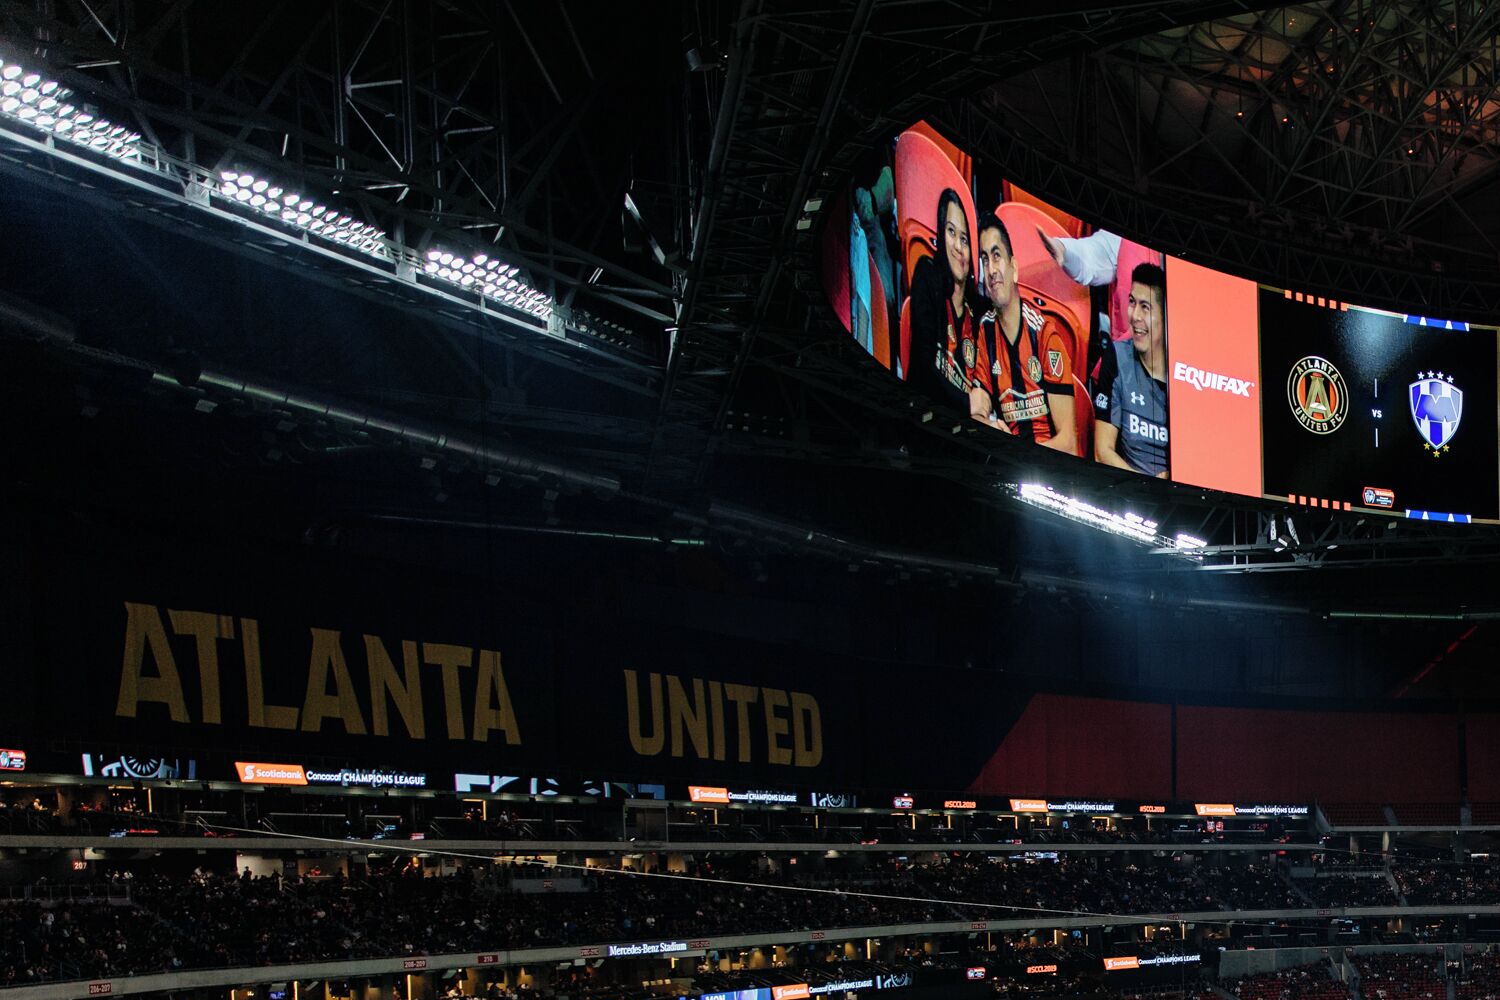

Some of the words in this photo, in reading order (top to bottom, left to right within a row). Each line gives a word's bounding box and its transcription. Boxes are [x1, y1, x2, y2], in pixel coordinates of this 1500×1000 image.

[1173, 361, 1251, 397] EQUIFAX
[1296, 360, 1339, 383] ATLANTA
[1129, 414, 1168, 442] Bana
[1295, 408, 1329, 432] UNITED
[1330, 413, 1342, 429] FC
[115, 601, 522, 747] ATLANTA
[624, 669, 823, 767] UNITED
[256, 768, 302, 780] Scotiabank
[306, 770, 342, 781] Concacaf
[343, 772, 393, 784] CHAMPIONS
[394, 775, 426, 785] LEAGUE
[749, 793, 778, 801] CHAMPIONS
[778, 794, 797, 802] LEAGUE
[944, 801, 976, 809] #SCCL2019
[1257, 806, 1287, 814] CHAMPIONS
[609, 944, 659, 957] Mercedes-Benz
[659, 941, 687, 953] Stadium
[1157, 956, 1183, 965] CHAMPIONS
[1183, 954, 1201, 962] LEAGUE
[1027, 964, 1058, 974] #SCCL2019
[828, 981, 855, 992] CHAMPIONS
[855, 979, 873, 988] LEAGUE
